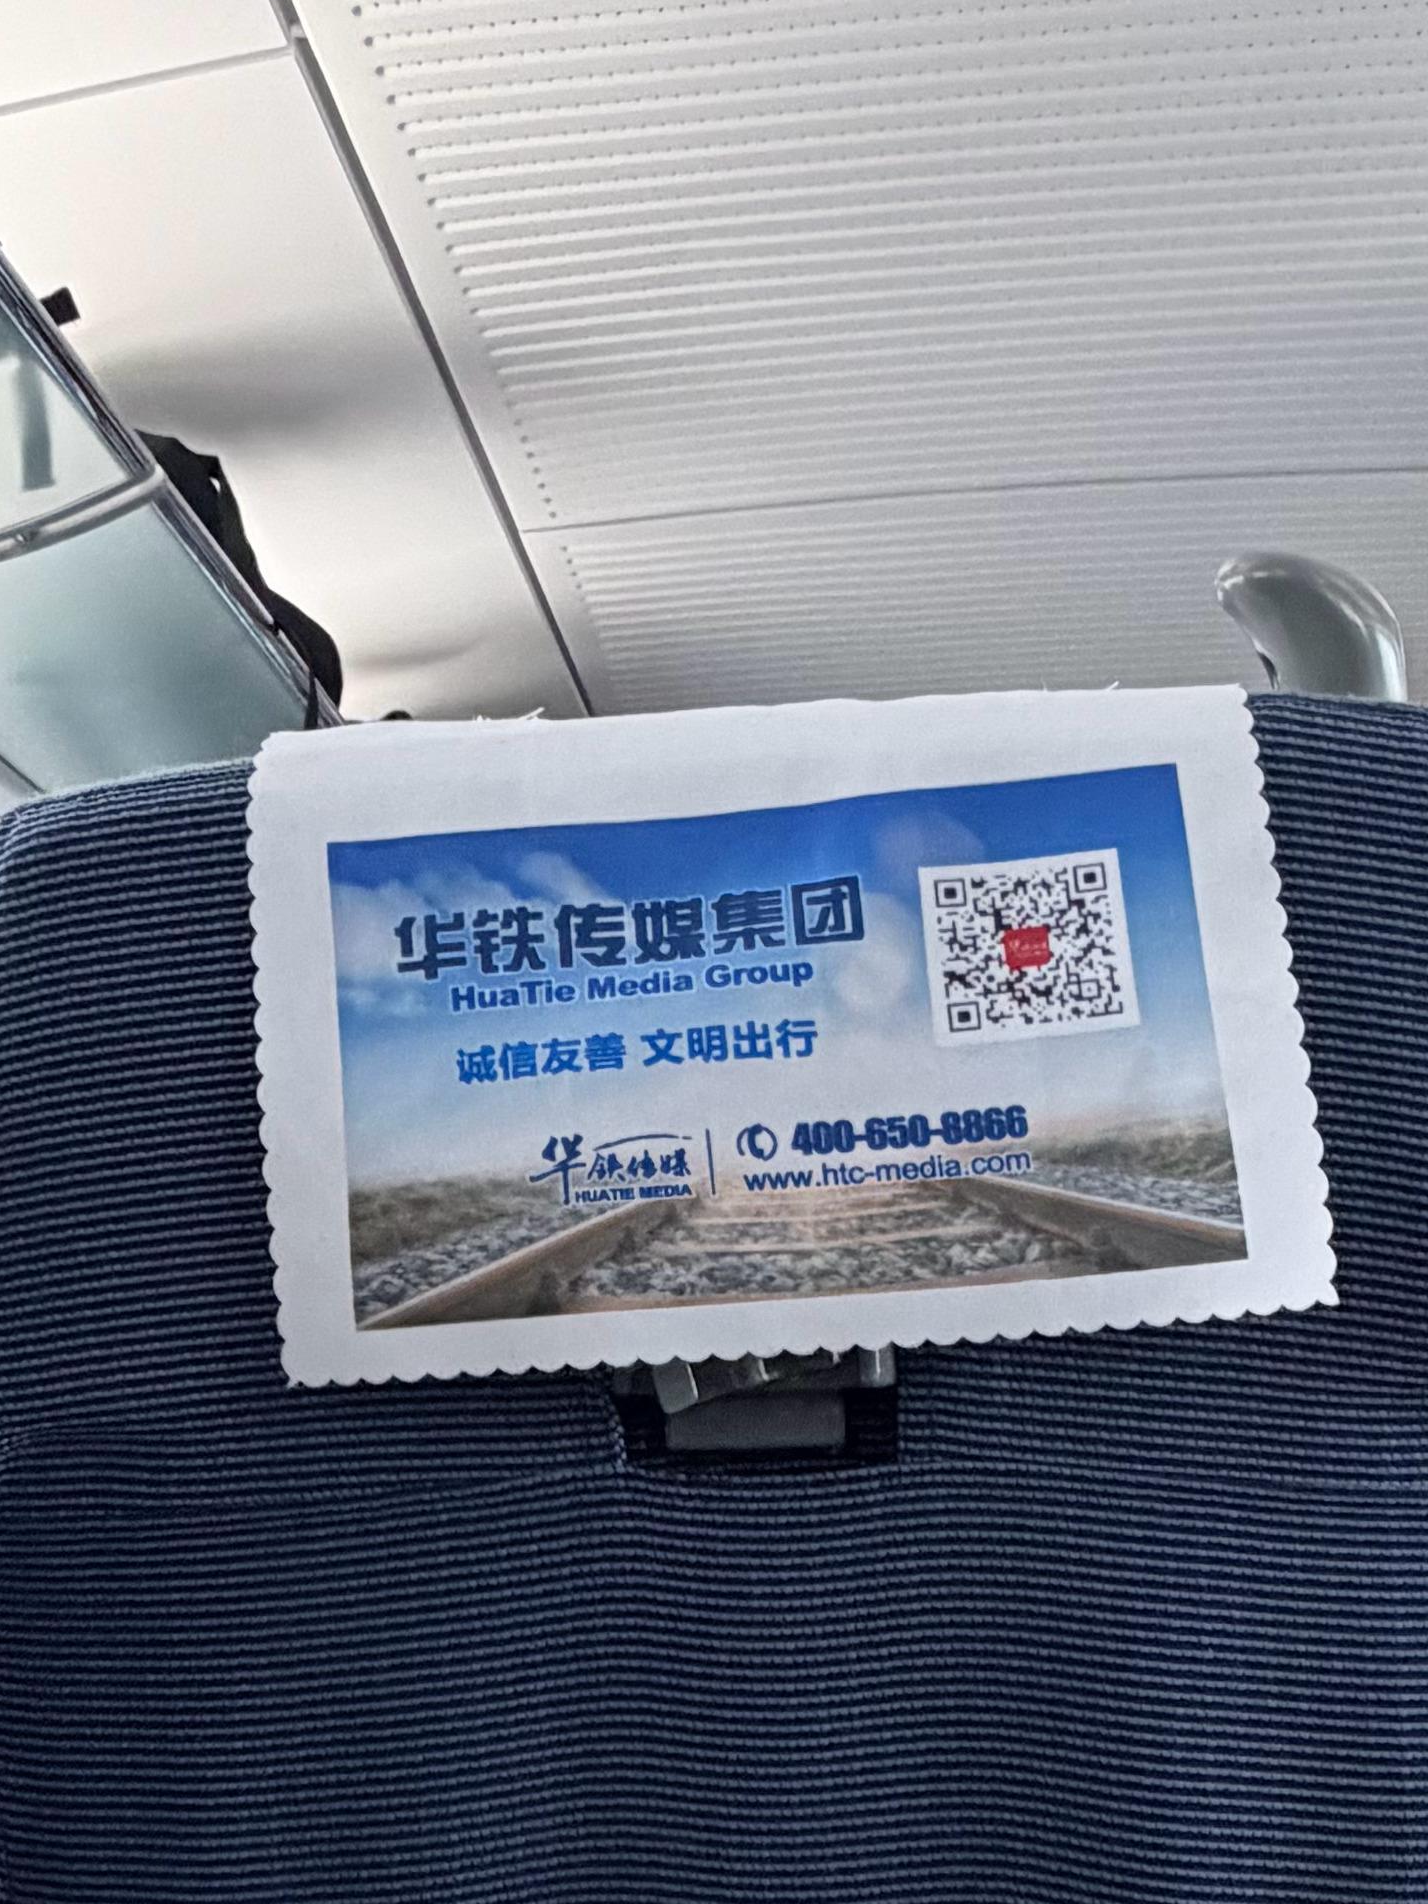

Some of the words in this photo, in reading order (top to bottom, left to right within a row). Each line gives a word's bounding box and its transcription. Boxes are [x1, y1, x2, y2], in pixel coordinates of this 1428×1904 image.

[393, 875, 865, 980] 华铁传媒集团
[450, 979, 576, 1012] HuaTie
[587, 968, 694, 1001] Media
[704, 960, 814, 989] Group
[456, 1033, 627, 1085] 诚信友善
[640, 1018, 819, 1067] 文明出行
[791, 1104, 1030, 1156] 400-650-8866
[575, 1186, 636, 1204] HUATIE
[638, 1183, 692, 1198] MEDIA
[743, 1151, 1032, 1192] www.htc-media.com
